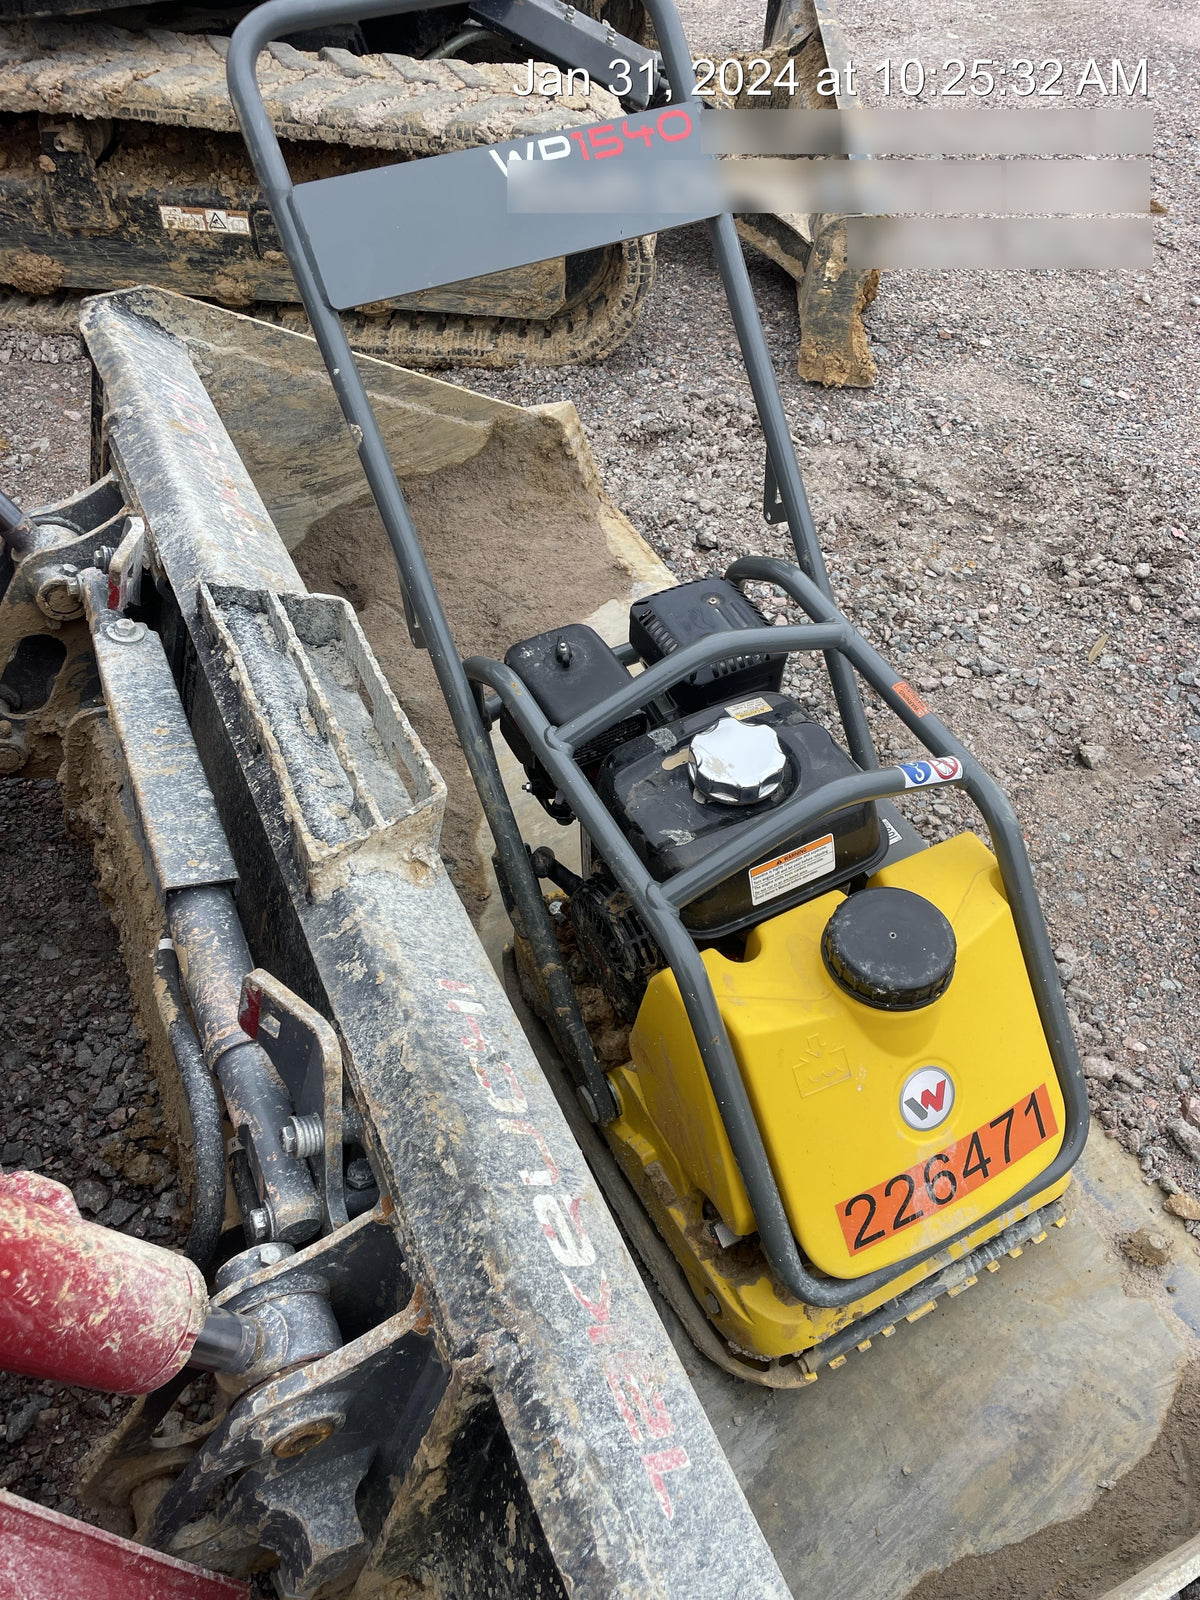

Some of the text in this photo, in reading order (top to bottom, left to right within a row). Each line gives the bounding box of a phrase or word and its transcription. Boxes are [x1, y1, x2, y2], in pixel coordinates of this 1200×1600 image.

[783, 847, 806, 861] WARNING
[903, 1079, 947, 1121] W
[845, 1092, 1047, 1250] 226471
